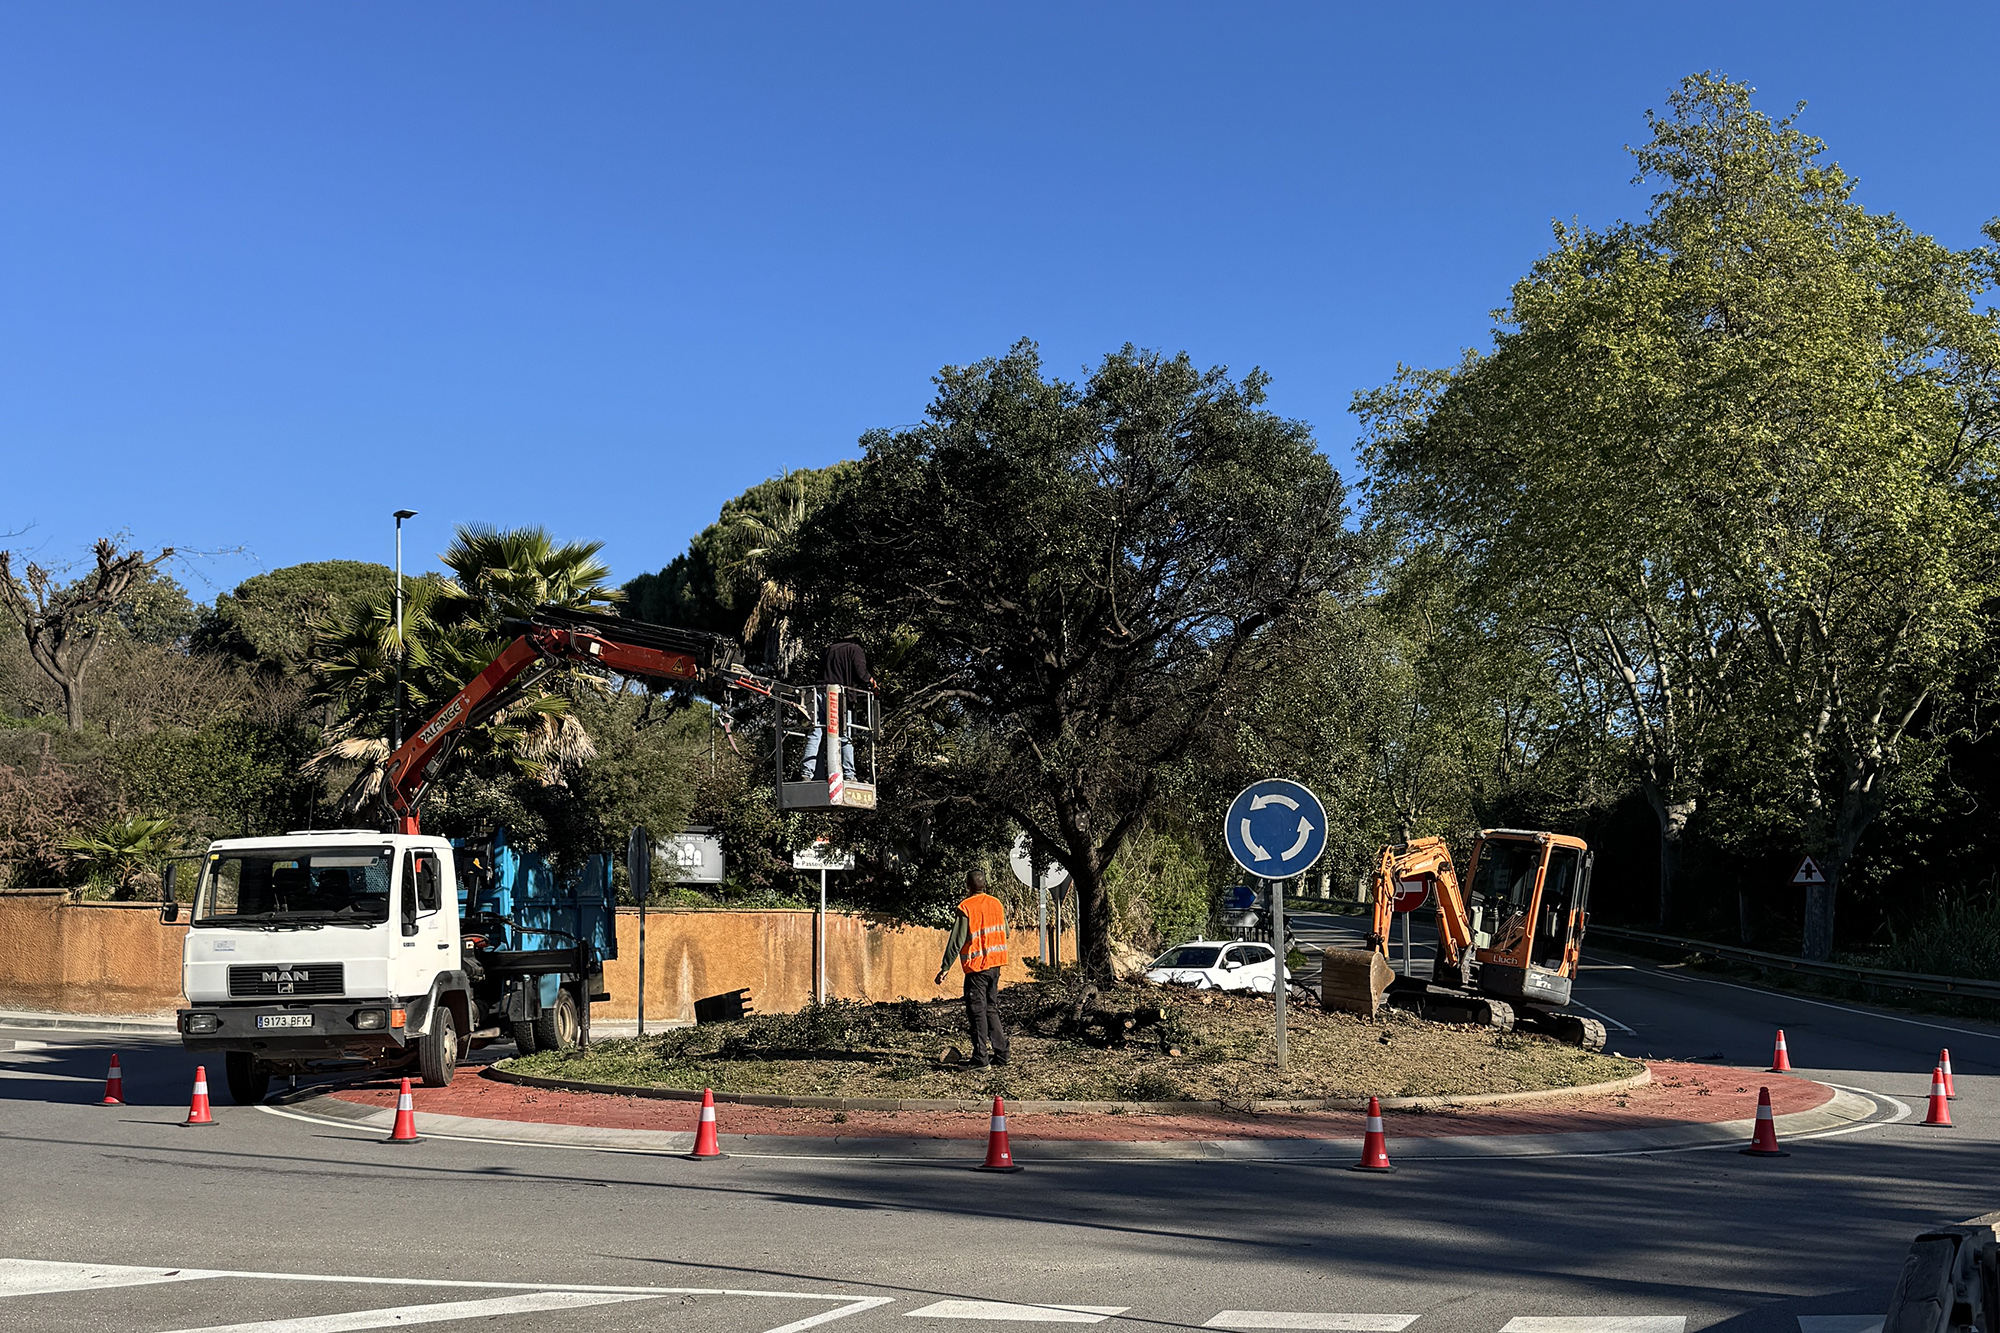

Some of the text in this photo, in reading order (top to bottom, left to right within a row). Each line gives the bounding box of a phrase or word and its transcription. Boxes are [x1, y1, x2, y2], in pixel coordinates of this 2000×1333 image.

[828, 691, 838, 734] Ferrari
[419, 698, 463, 744] PALFINGE
[1493, 955, 1518, 965] Lluch
[262, 971, 309, 982] MAN
[264, 1016, 308, 1027] 9173 BFK
